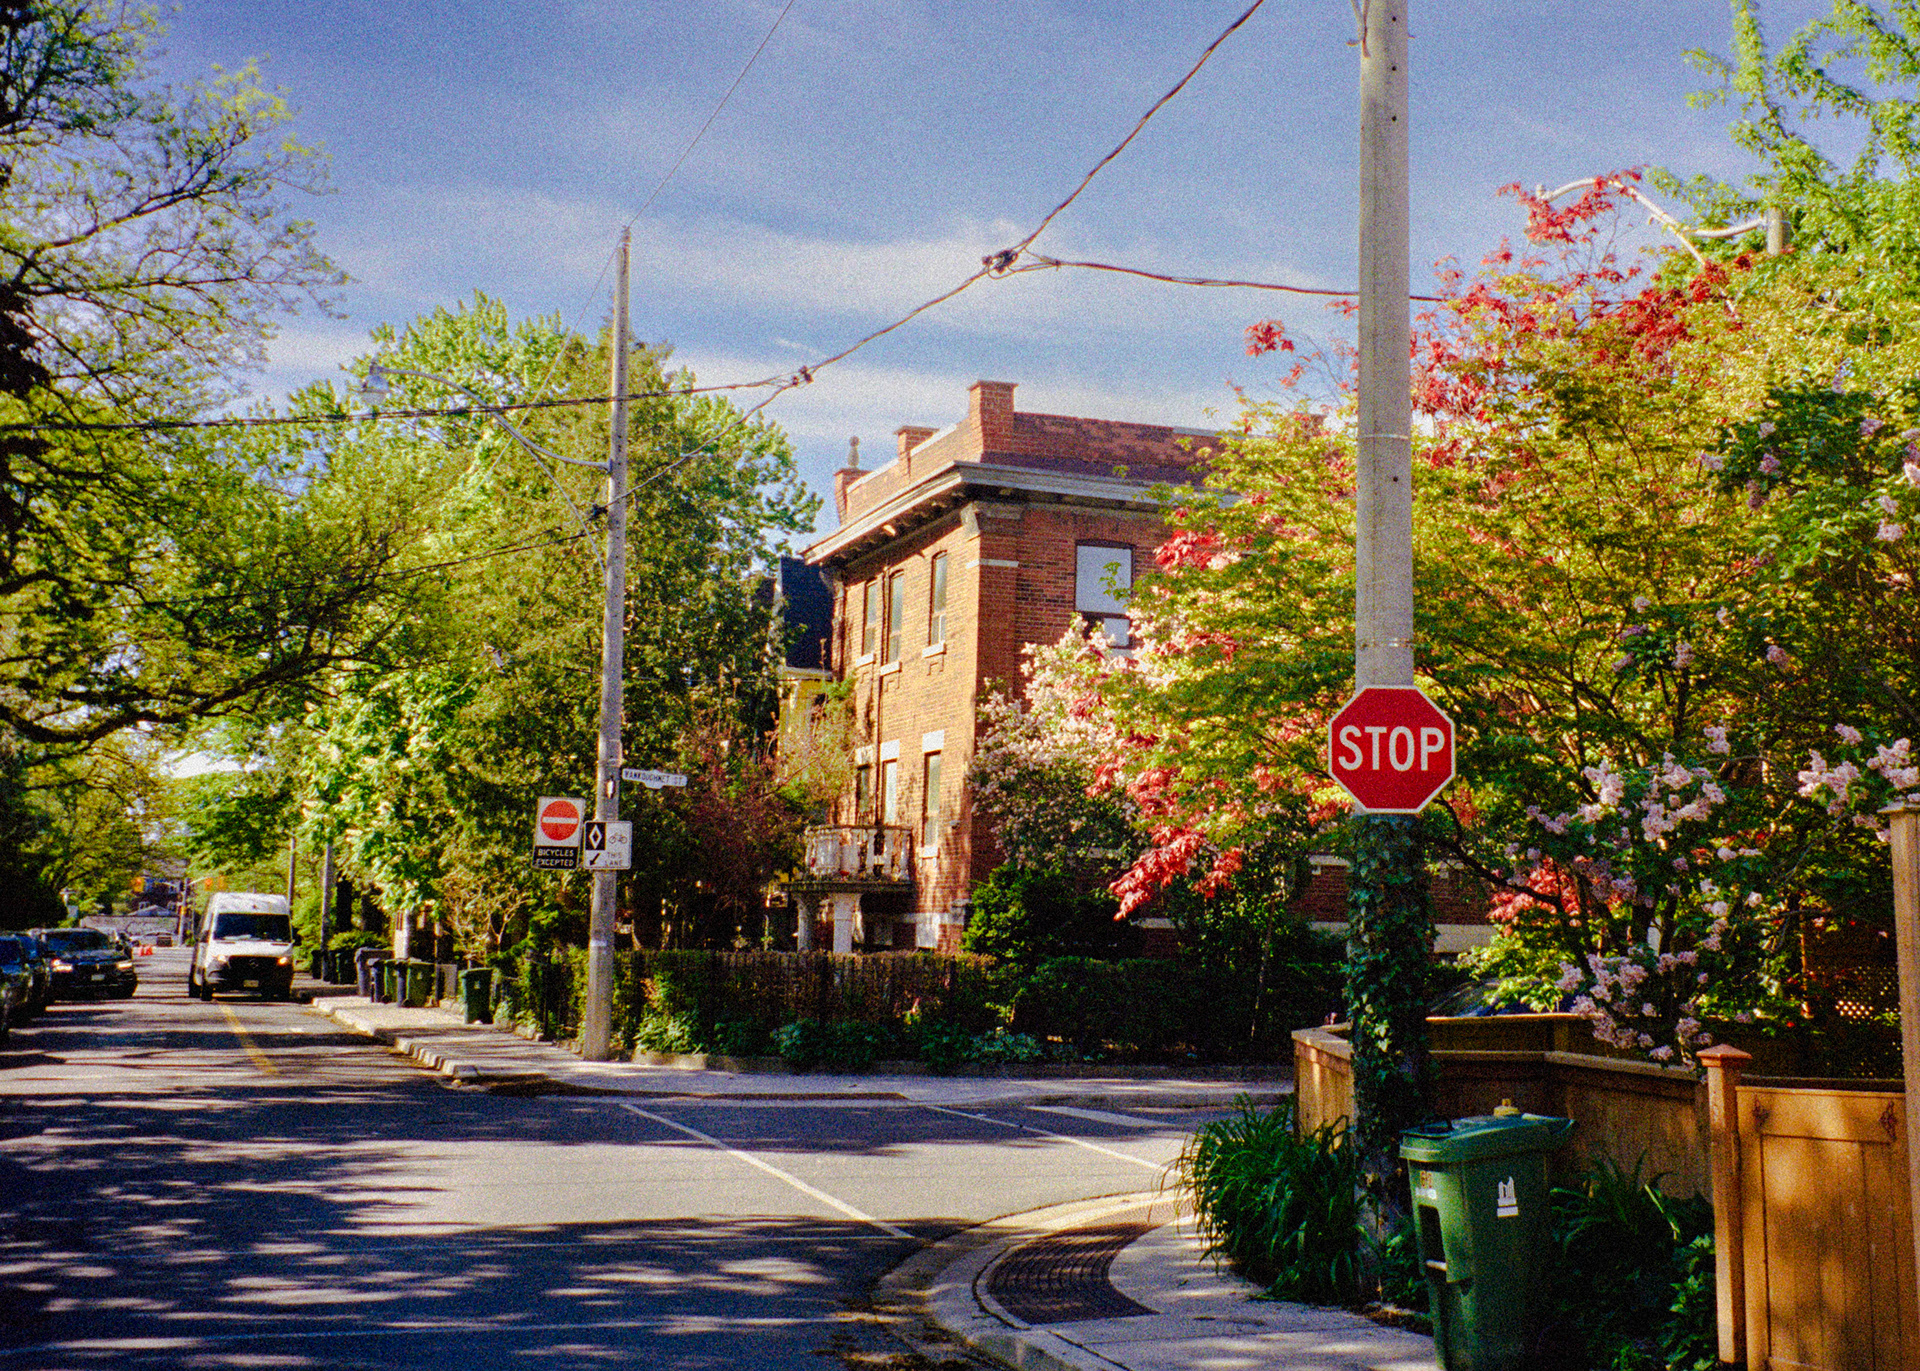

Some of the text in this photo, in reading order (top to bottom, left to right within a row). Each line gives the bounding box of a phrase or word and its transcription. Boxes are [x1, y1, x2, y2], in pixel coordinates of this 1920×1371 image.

[1338, 725, 1445, 771] STOP
[537, 848, 574, 857] BICYCLES
[536, 858, 575, 867] EXCEPTED
